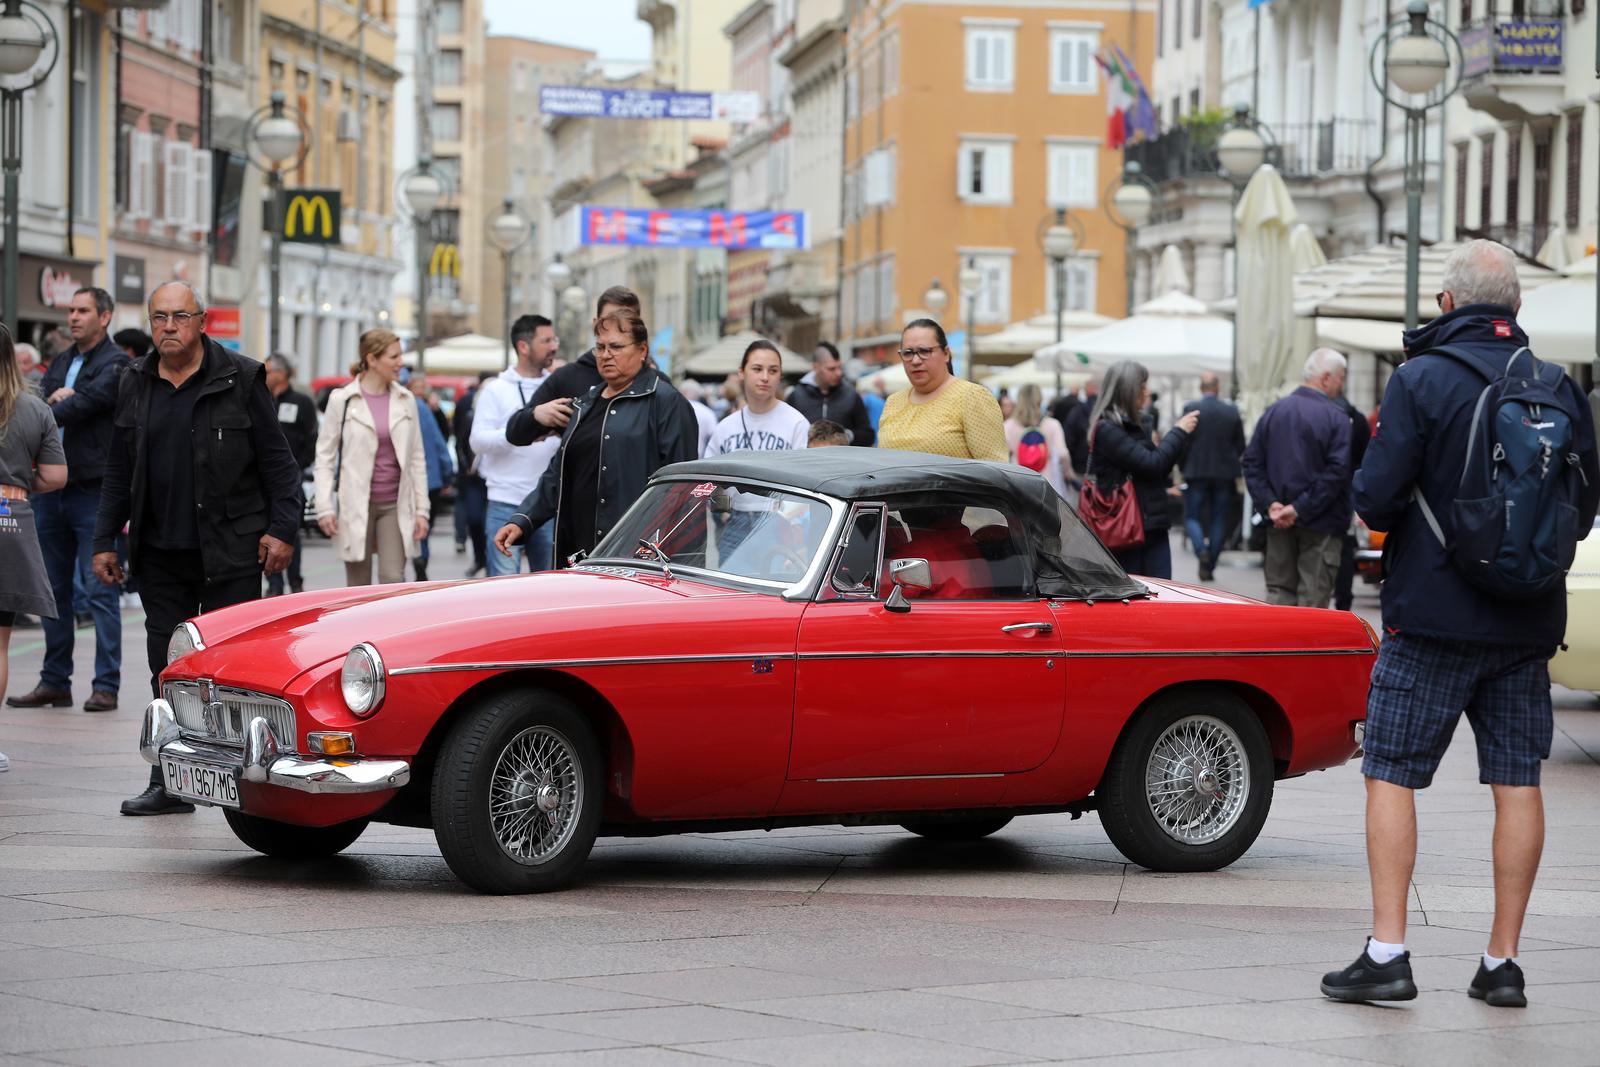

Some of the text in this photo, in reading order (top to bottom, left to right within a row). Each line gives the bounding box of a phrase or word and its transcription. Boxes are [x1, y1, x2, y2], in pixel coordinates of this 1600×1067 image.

[1502, 25, 1560, 39] HAPPY
[1499, 43, 1560, 56] HOSTEL
[167, 762, 183, 791] PU
